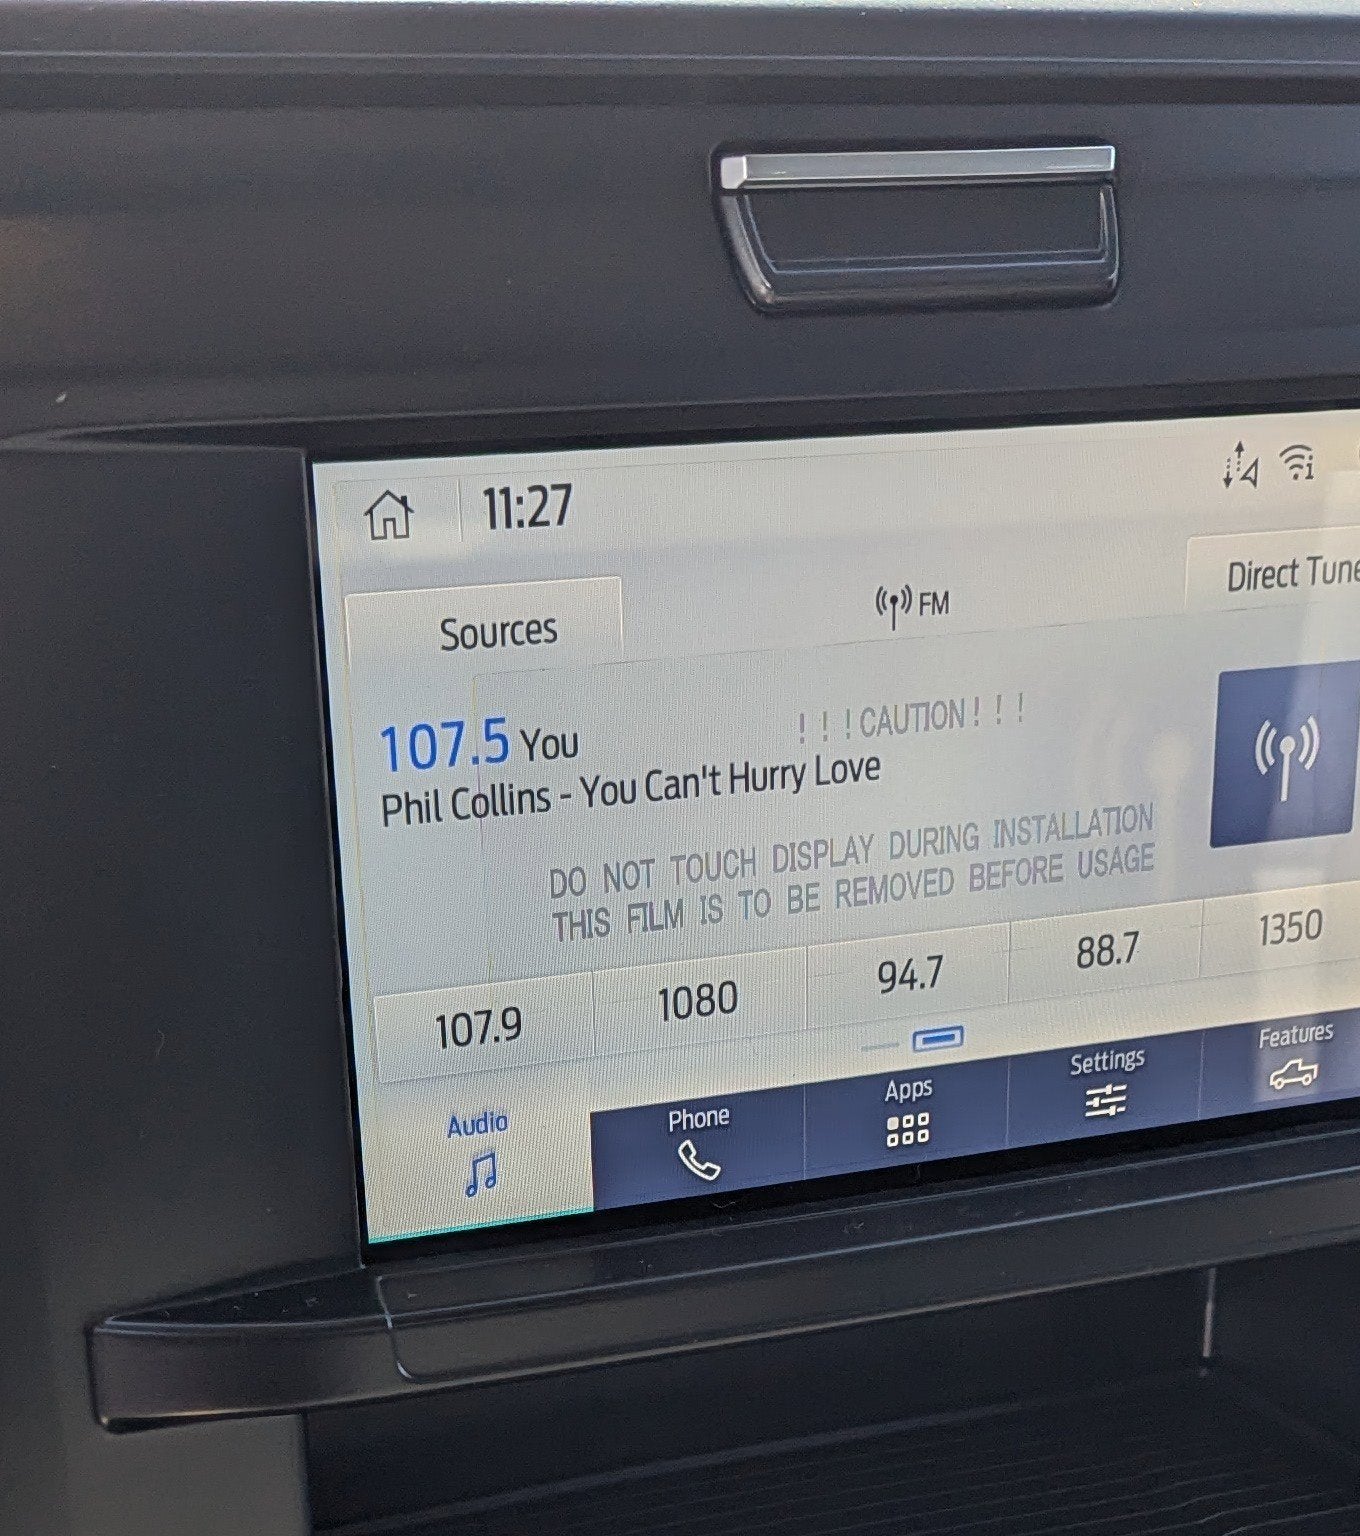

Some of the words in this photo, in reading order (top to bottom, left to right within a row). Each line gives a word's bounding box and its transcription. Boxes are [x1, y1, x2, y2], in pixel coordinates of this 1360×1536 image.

[482, 483, 573, 531] 11:27
[1227, 557, 1299, 592] Direct
[918, 591, 950, 616] FM
[440, 617, 558, 651] Sources
[381, 717, 510, 772] 107.5
[520, 728, 579, 762] You
[382, 790, 443, 828] Phil
[451, 782, 552, 820] Collins
[580, 776, 638, 807] You
[645, 764, 723, 801] Can't
[730, 757, 806, 796] Hurry
[815, 753, 881, 787] Love
[549, 867, 587, 899] DO
[603, 858, 655, 894] NOT
[670, 848, 757, 887] TOUCH
[772, 834, 876, 875] DISPLAY
[889, 820, 980, 860] DURING
[993, 801, 1155, 847] INSTALLATION
[552, 906, 612, 943] THIS
[627, 898, 685, 935] FILM
[700, 894, 724, 925] IS
[737, 887, 772, 919] TO
[787, 879, 821, 915] BE
[836, 866, 955, 910] REMOVED
[969, 852, 1063, 891] BEFORE
[1077, 841, 1155, 879] USAGE
[1260, 908, 1324, 947] 1350
[1076, 930, 1140, 969] 88.7
[878, 955, 944, 994] 94.7
[658, 980, 739, 1022] 1080
[435, 1005, 523, 1049] 107.9
[1258, 1021, 1335, 1050] Features
[1070, 1047, 1146, 1078] Settings
[884, 1078, 933, 1105] Apps
[447, 1111, 508, 1139] Audio
[668, 1105, 730, 1133] Phone
